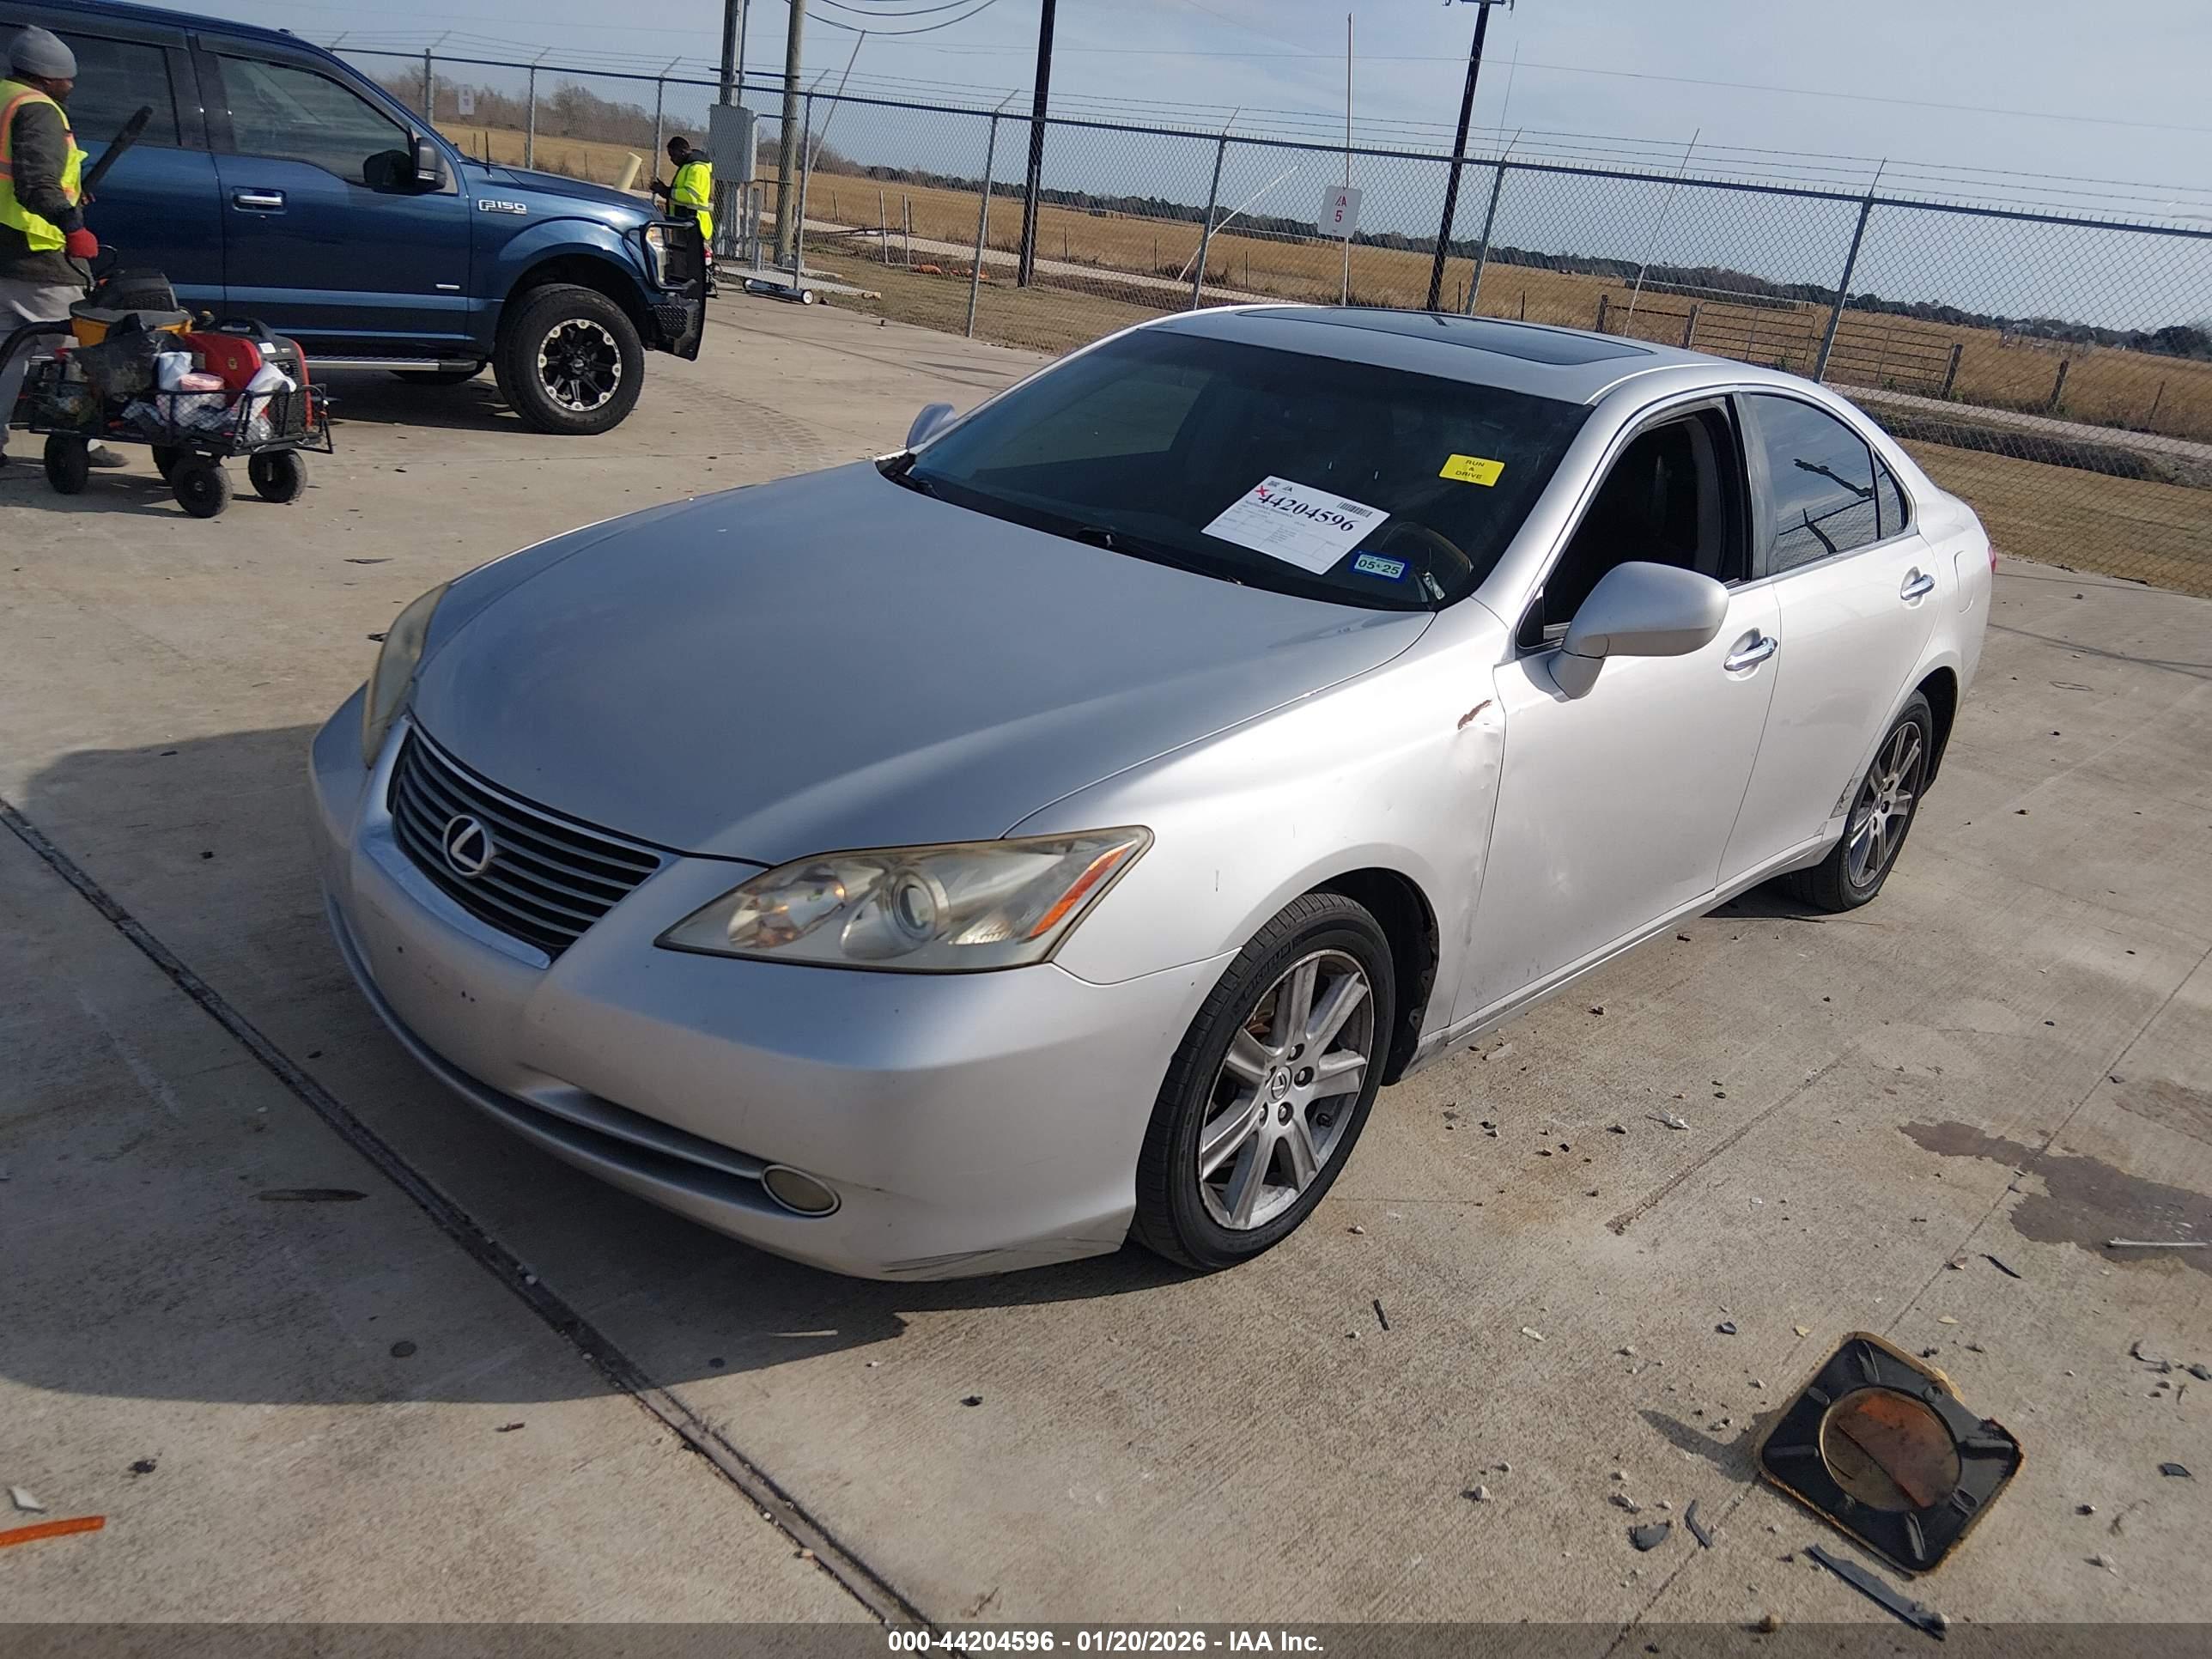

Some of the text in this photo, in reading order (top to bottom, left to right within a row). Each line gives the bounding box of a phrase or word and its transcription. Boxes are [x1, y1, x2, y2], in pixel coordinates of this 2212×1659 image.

[1334, 210, 1343, 222] 5
[1455, 470, 1483, 479] DRIVE
[1258, 493, 1359, 532] 44204596
[1358, 559, 1376, 569] 05
[1381, 564, 1401, 574] 25
